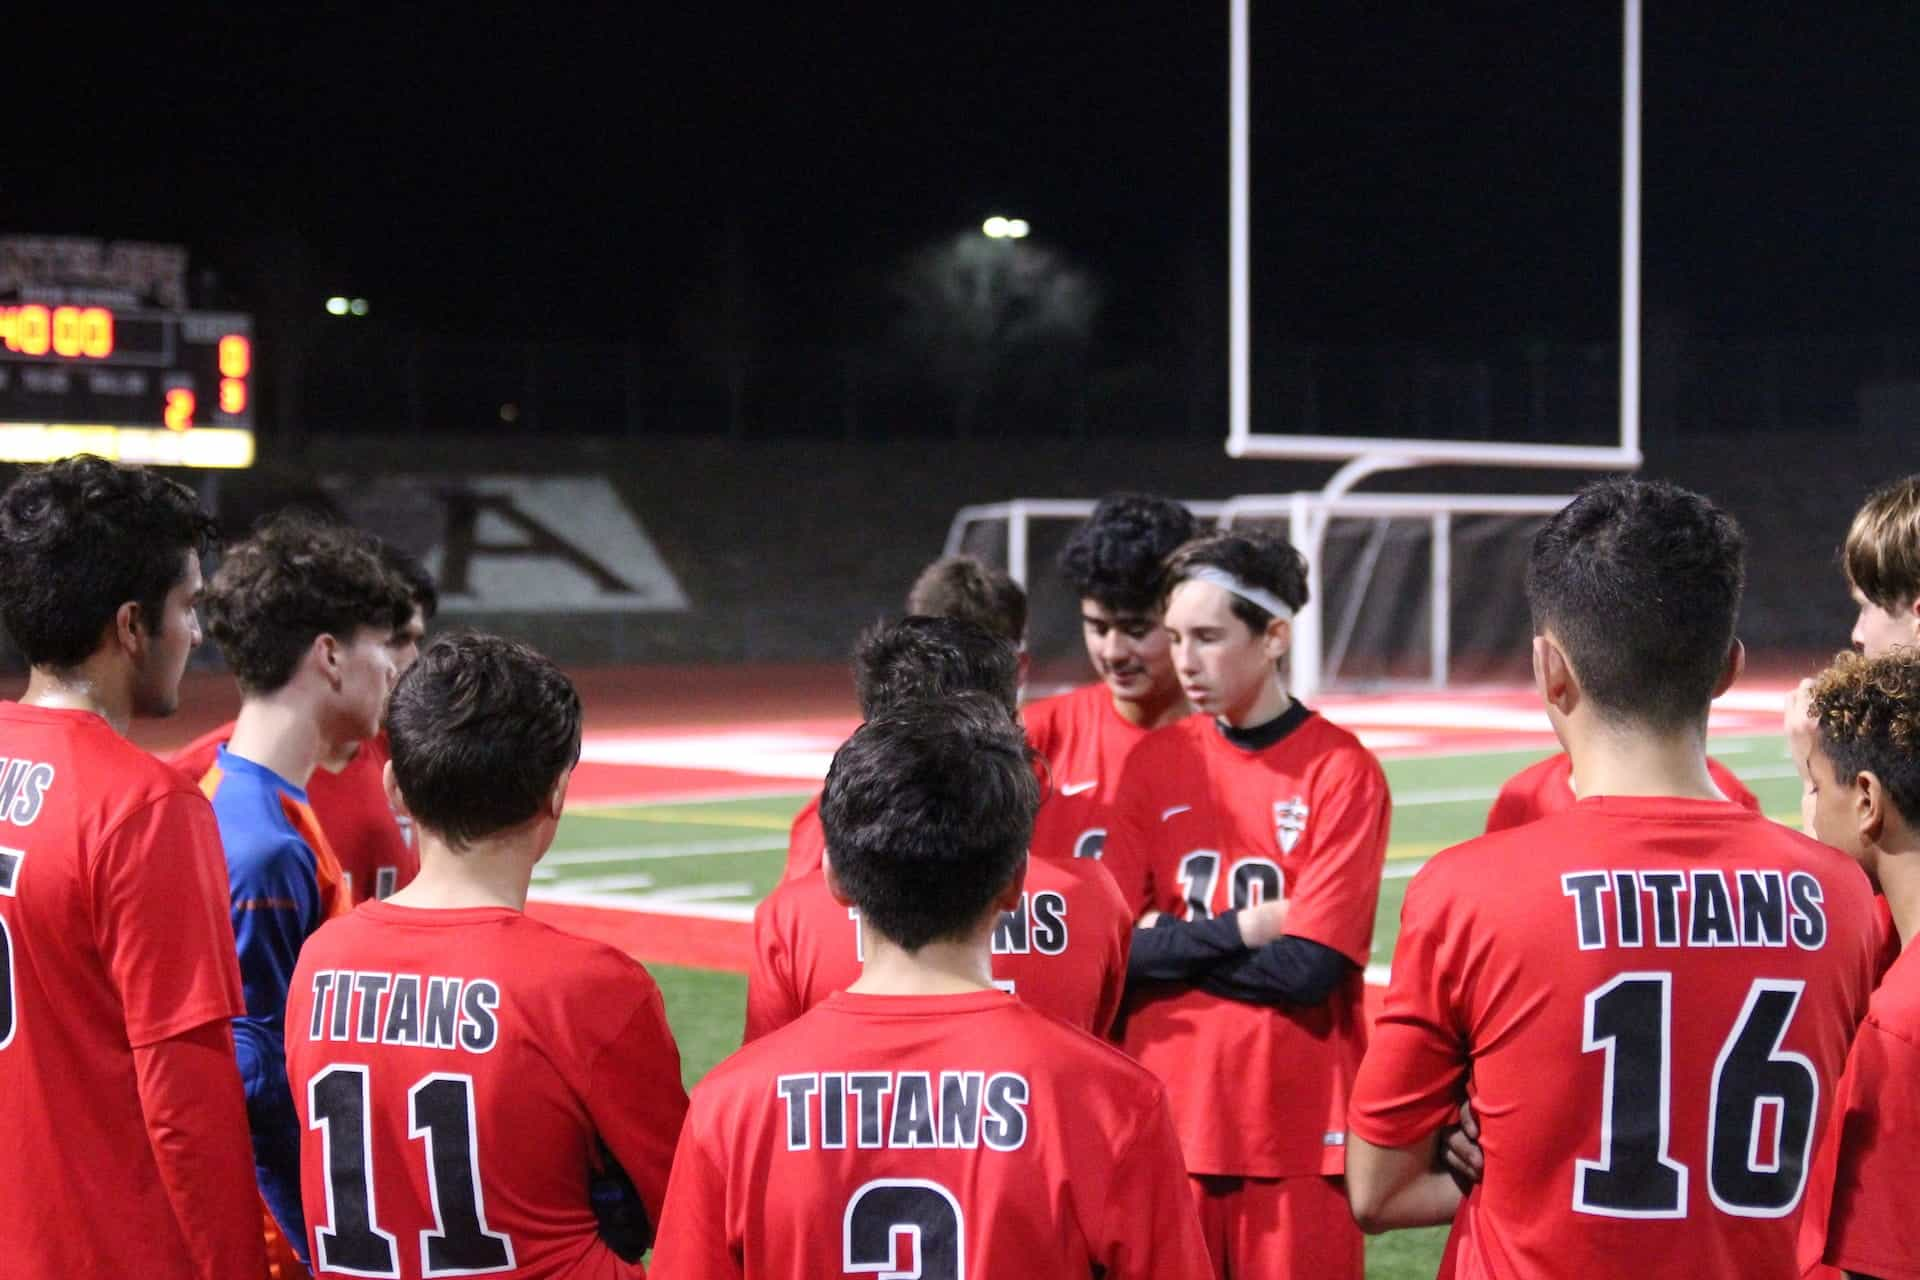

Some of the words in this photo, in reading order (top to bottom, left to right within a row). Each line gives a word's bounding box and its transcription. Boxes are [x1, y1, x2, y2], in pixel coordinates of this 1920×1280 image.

[164, 388, 195, 431] 2
[1560, 869, 1827, 951] TITANS
[309, 969, 500, 1054] TITANS
[777, 1071, 1029, 1152] TITANS
[1572, 971, 1819, 1219] 16
[308, 1063, 517, 1279] 11
